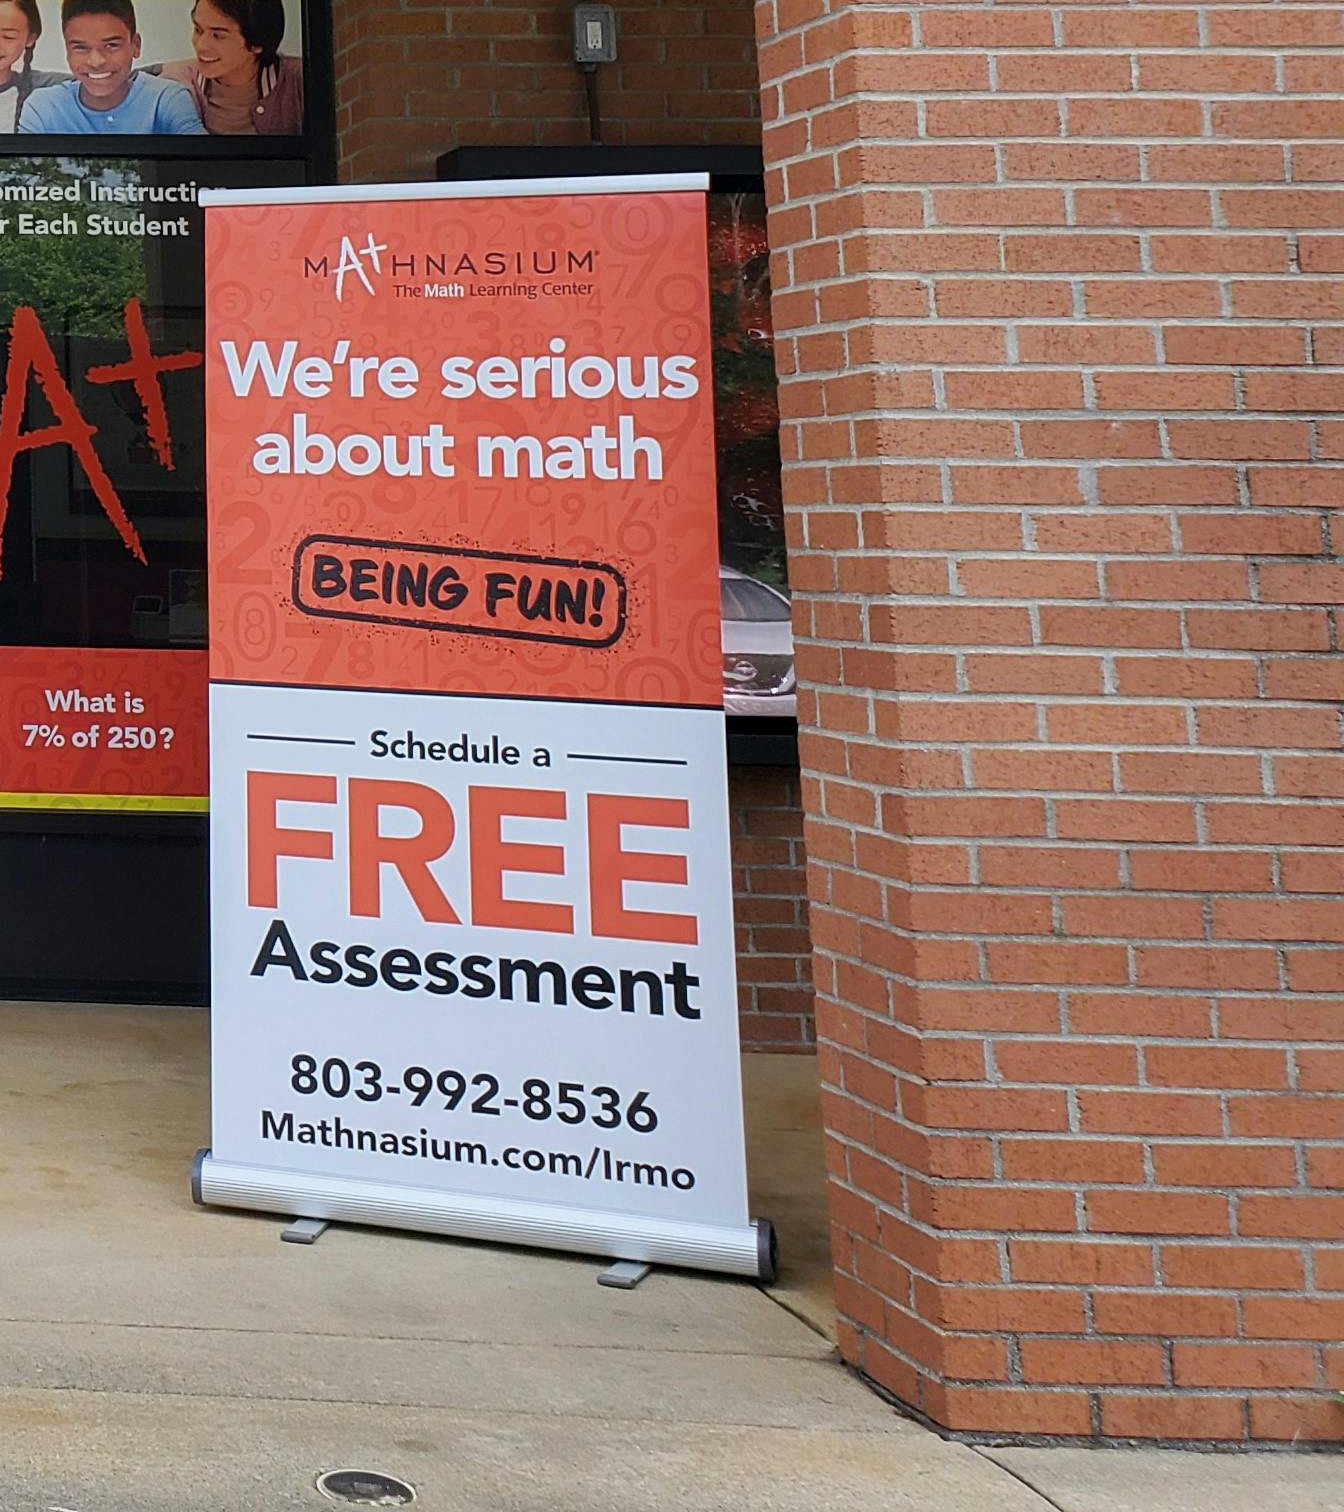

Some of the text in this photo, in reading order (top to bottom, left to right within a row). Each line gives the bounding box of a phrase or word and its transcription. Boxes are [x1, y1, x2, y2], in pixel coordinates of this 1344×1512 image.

[89, 179, 198, 203] Instructi
[18, 212, 78, 236] Each
[86, 213, 190, 237] Student
[393, 280, 594, 301] The Math Learning Center
[220, 338, 699, 400] We're serious
[252, 413, 664, 481] about math
[311, 554, 607, 627] BEING FUN!
[45, 689, 145, 714] What is
[22, 724, 175, 750] 7% of 250?
[369, 730, 552, 769] Schedule a
[246, 770, 700, 947] FREE
[250, 919, 702, 1021] Assessment
[290, 1053, 659, 1135] 803-992-8536
[260, 1109, 696, 1192] Mathnasium.com/Irmo
